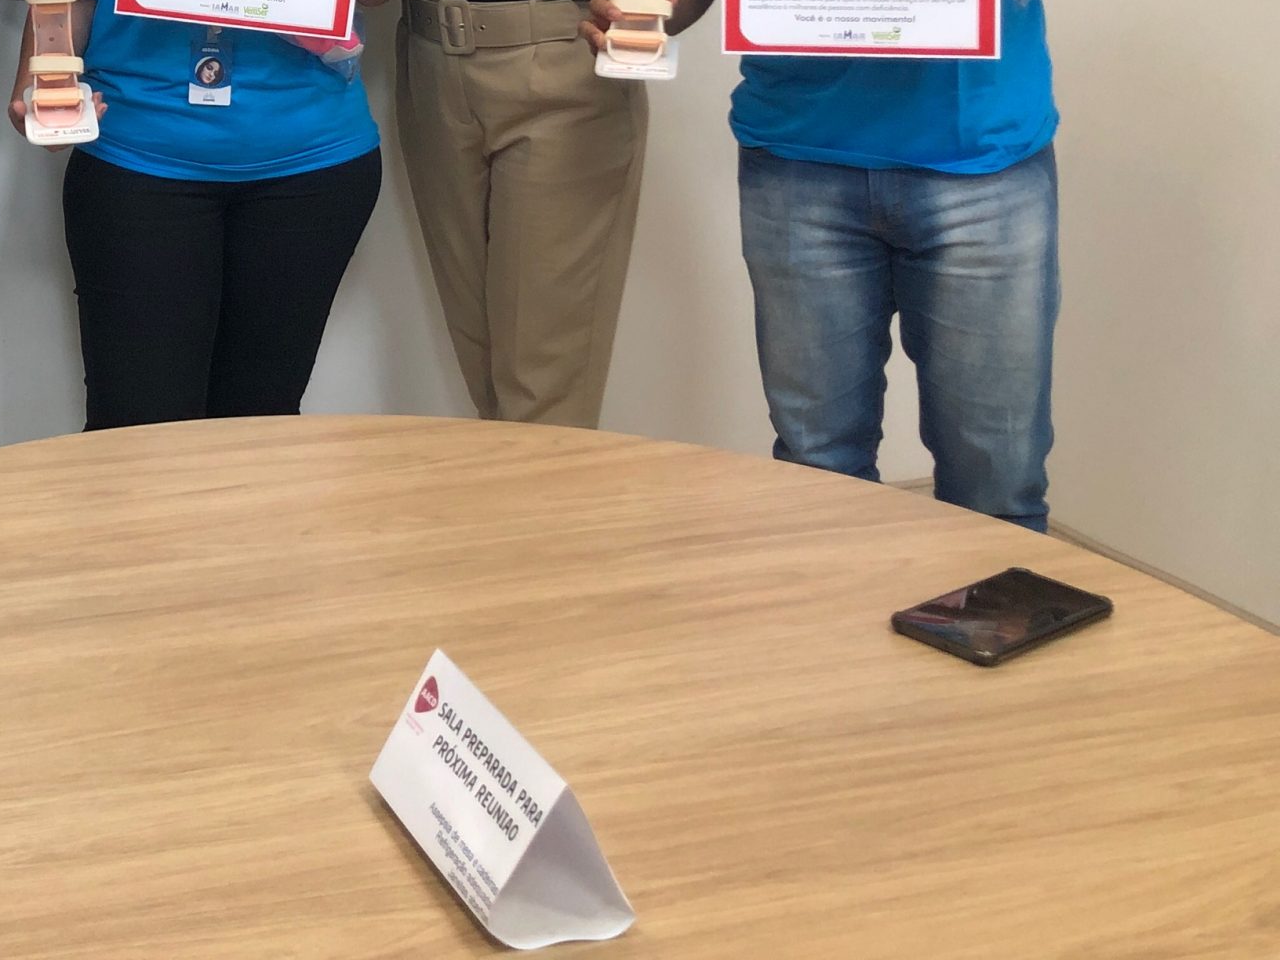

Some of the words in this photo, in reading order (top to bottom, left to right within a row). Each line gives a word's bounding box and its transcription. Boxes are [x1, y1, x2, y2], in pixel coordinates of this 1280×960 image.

[794, 14, 815, 22] Você
[863, 15, 915, 23] movimento!
[432, 735, 478, 792] PRÓXIMA
[438, 702, 463, 736] SALA
[461, 728, 518, 798] PREPARADA
[515, 789, 544, 828] PARA
